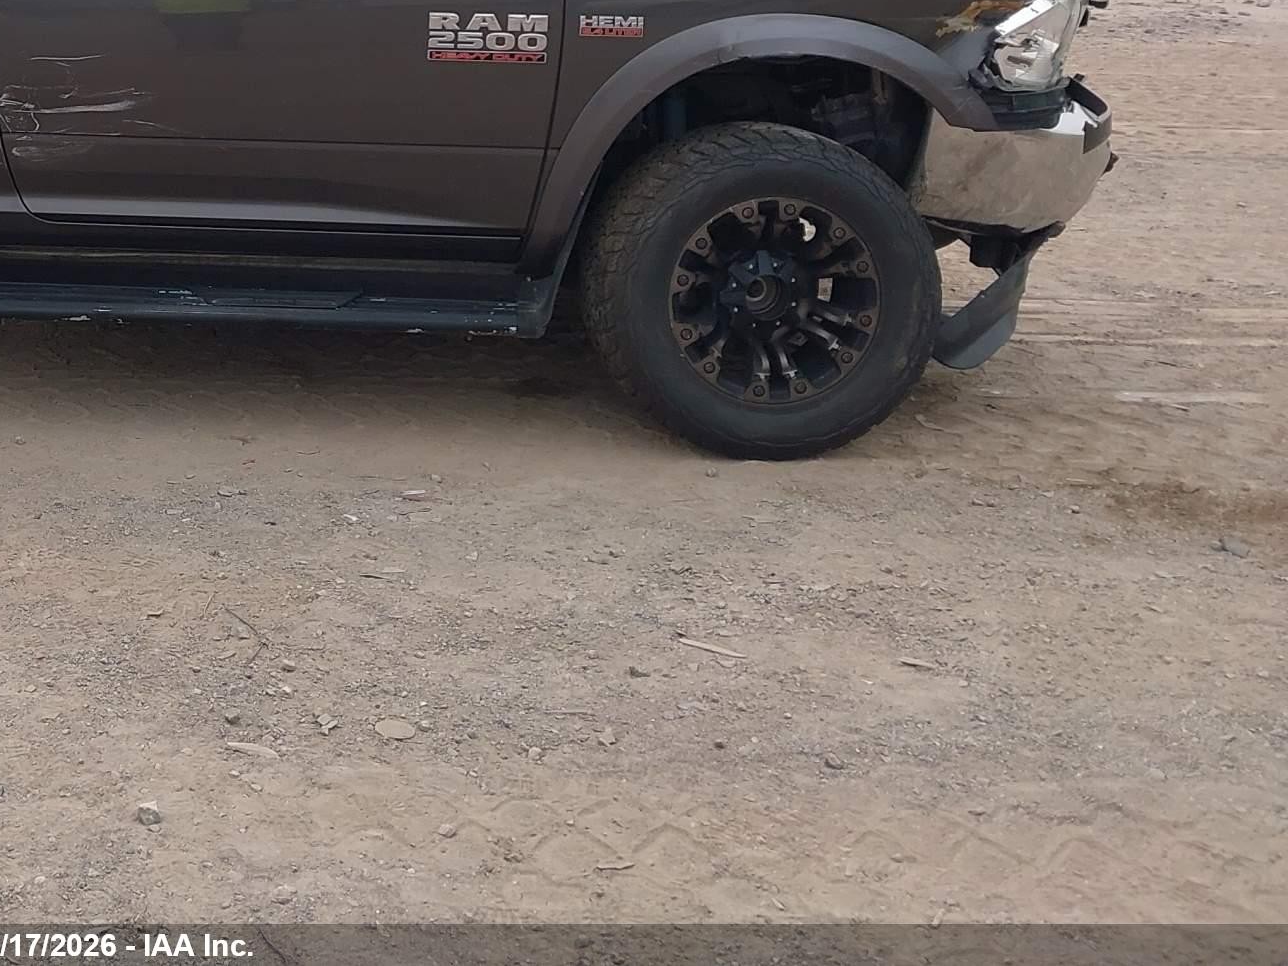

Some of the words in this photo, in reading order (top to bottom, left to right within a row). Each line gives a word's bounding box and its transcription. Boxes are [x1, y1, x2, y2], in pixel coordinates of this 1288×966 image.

[429, 12, 548, 32] RAM
[580, 15, 644, 27] HEMI
[428, 30, 547, 51] 2500
[432, 52, 490, 60] HEAVY
[492, 53, 543, 62] DUTY
